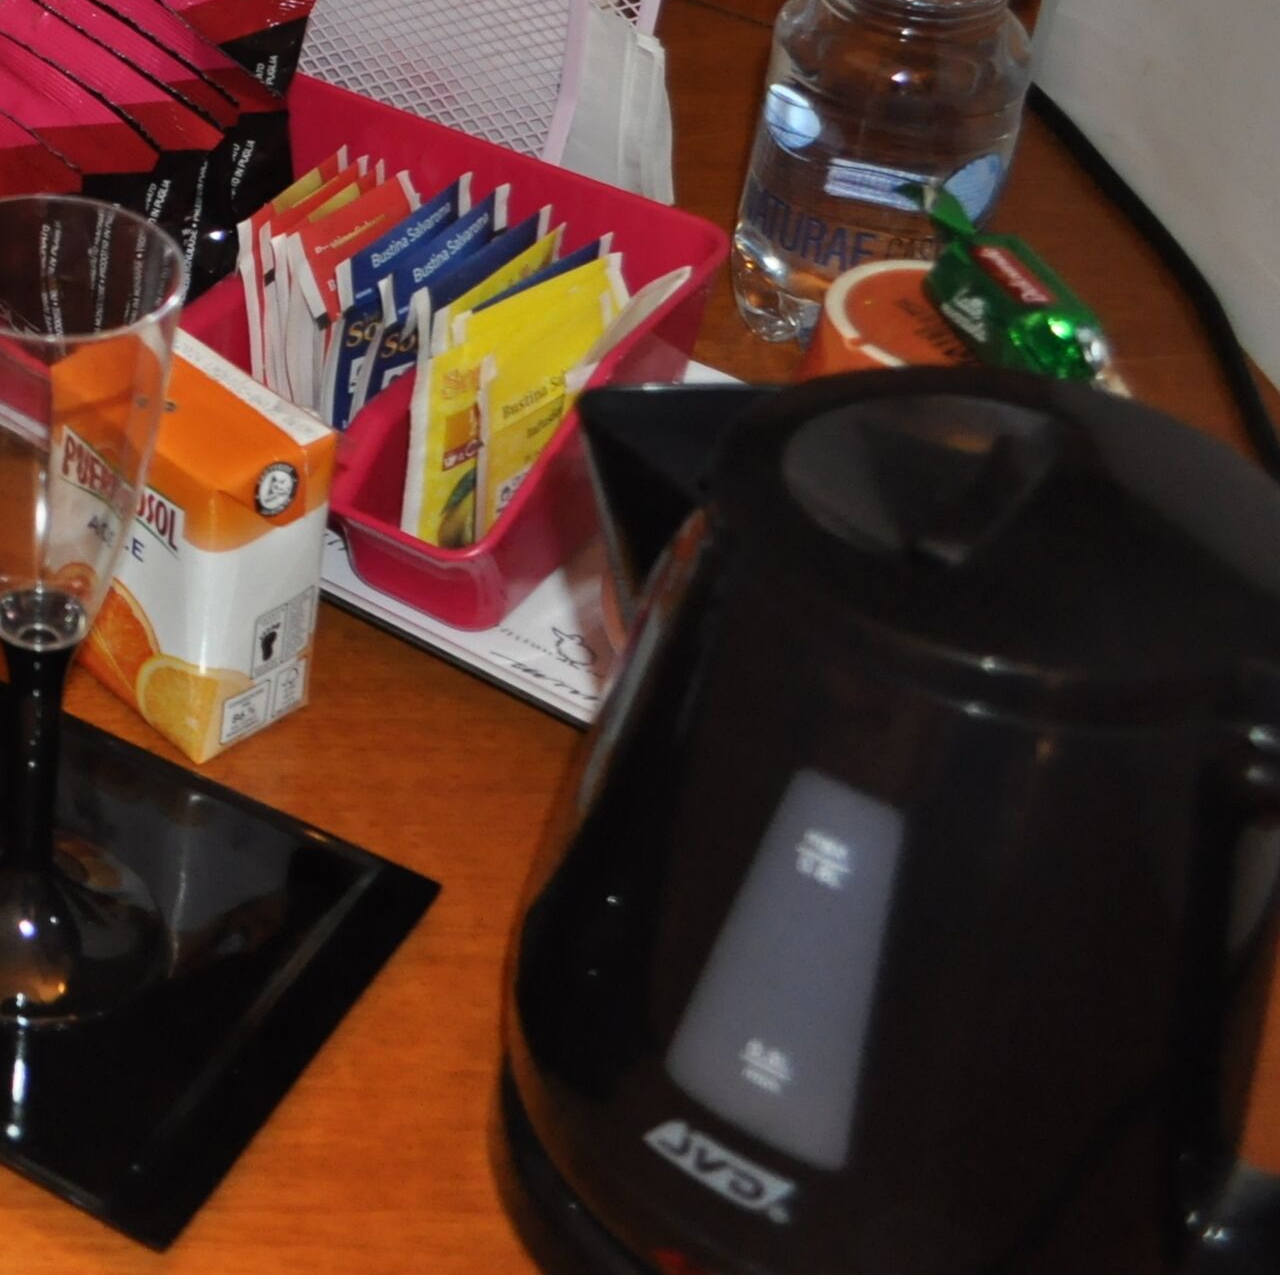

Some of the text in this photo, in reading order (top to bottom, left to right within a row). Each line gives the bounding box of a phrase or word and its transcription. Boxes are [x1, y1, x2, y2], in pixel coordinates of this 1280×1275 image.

[240, 140, 256, 168] PUGLIA
[155, 179, 172, 209] PUGLIA
[371, 237, 409, 268] Bustina
[412, 250, 450, 283] Bustina
